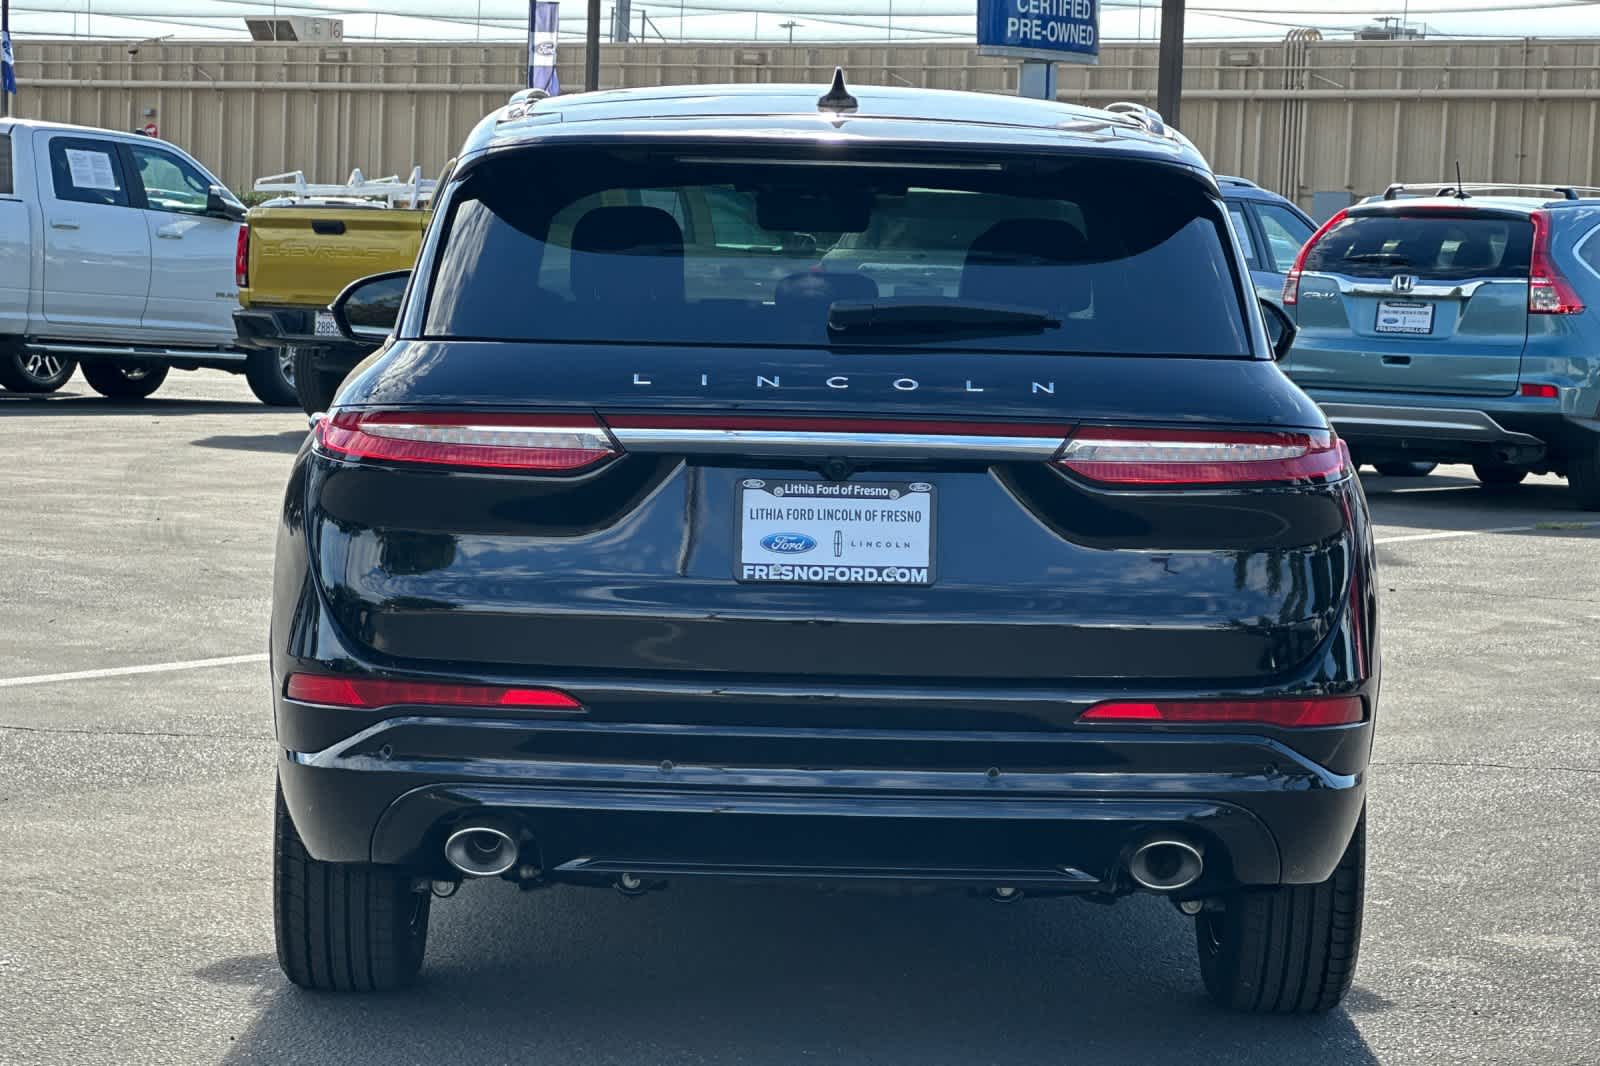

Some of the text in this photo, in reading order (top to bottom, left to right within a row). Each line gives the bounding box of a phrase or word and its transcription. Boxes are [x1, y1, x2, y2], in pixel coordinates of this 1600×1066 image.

[1017, 0, 1091, 19] CERTIFIED
[1007, 17, 1094, 46] PRE-OWNED
[633, 373, 1055, 395] LINCOLN
[784, 483, 889, 497] Lithia Ford of Fresno
[750, 508, 922, 523] LITHIA FORD LINCOLN OF FRESNO
[771, 535, 805, 551] Ford
[850, 540, 911, 549] LINCOLN
[742, 564, 928, 583] FRESNOFORD.COM
